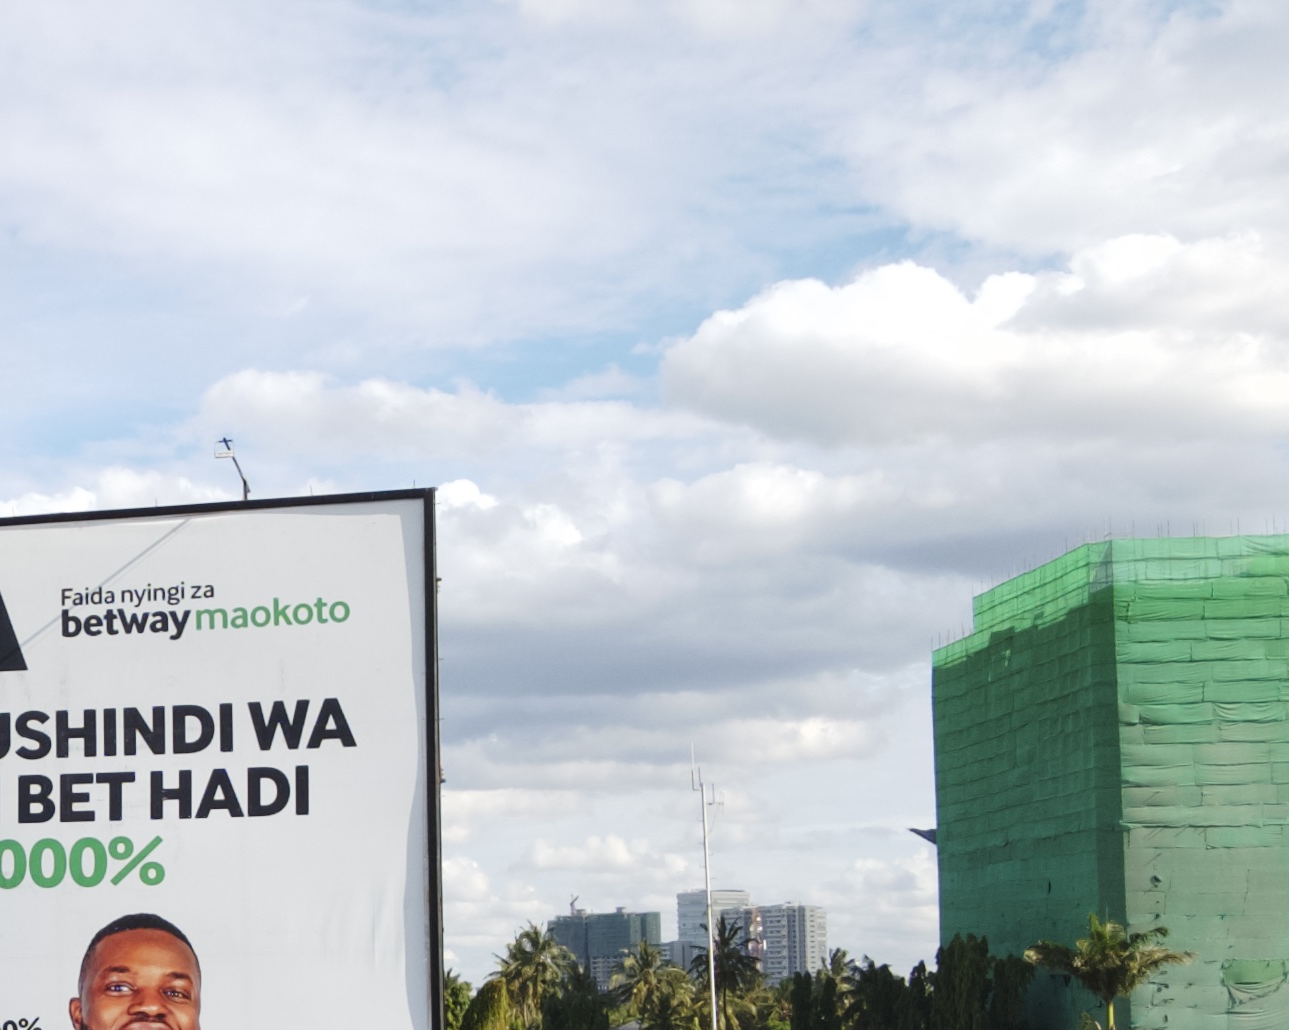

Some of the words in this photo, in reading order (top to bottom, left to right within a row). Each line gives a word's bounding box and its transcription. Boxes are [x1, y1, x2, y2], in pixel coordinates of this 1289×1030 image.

[61, 586, 115, 606] Faida
[121, 581, 185, 608] nyingi
[191, 584, 215, 599] za
[61, 608, 191, 641] betway
[195, 597, 351, 630] maokoto
[247, 697, 358, 751] WA
[17, 771, 136, 824] BET
[150, 764, 310, 820] HADI
